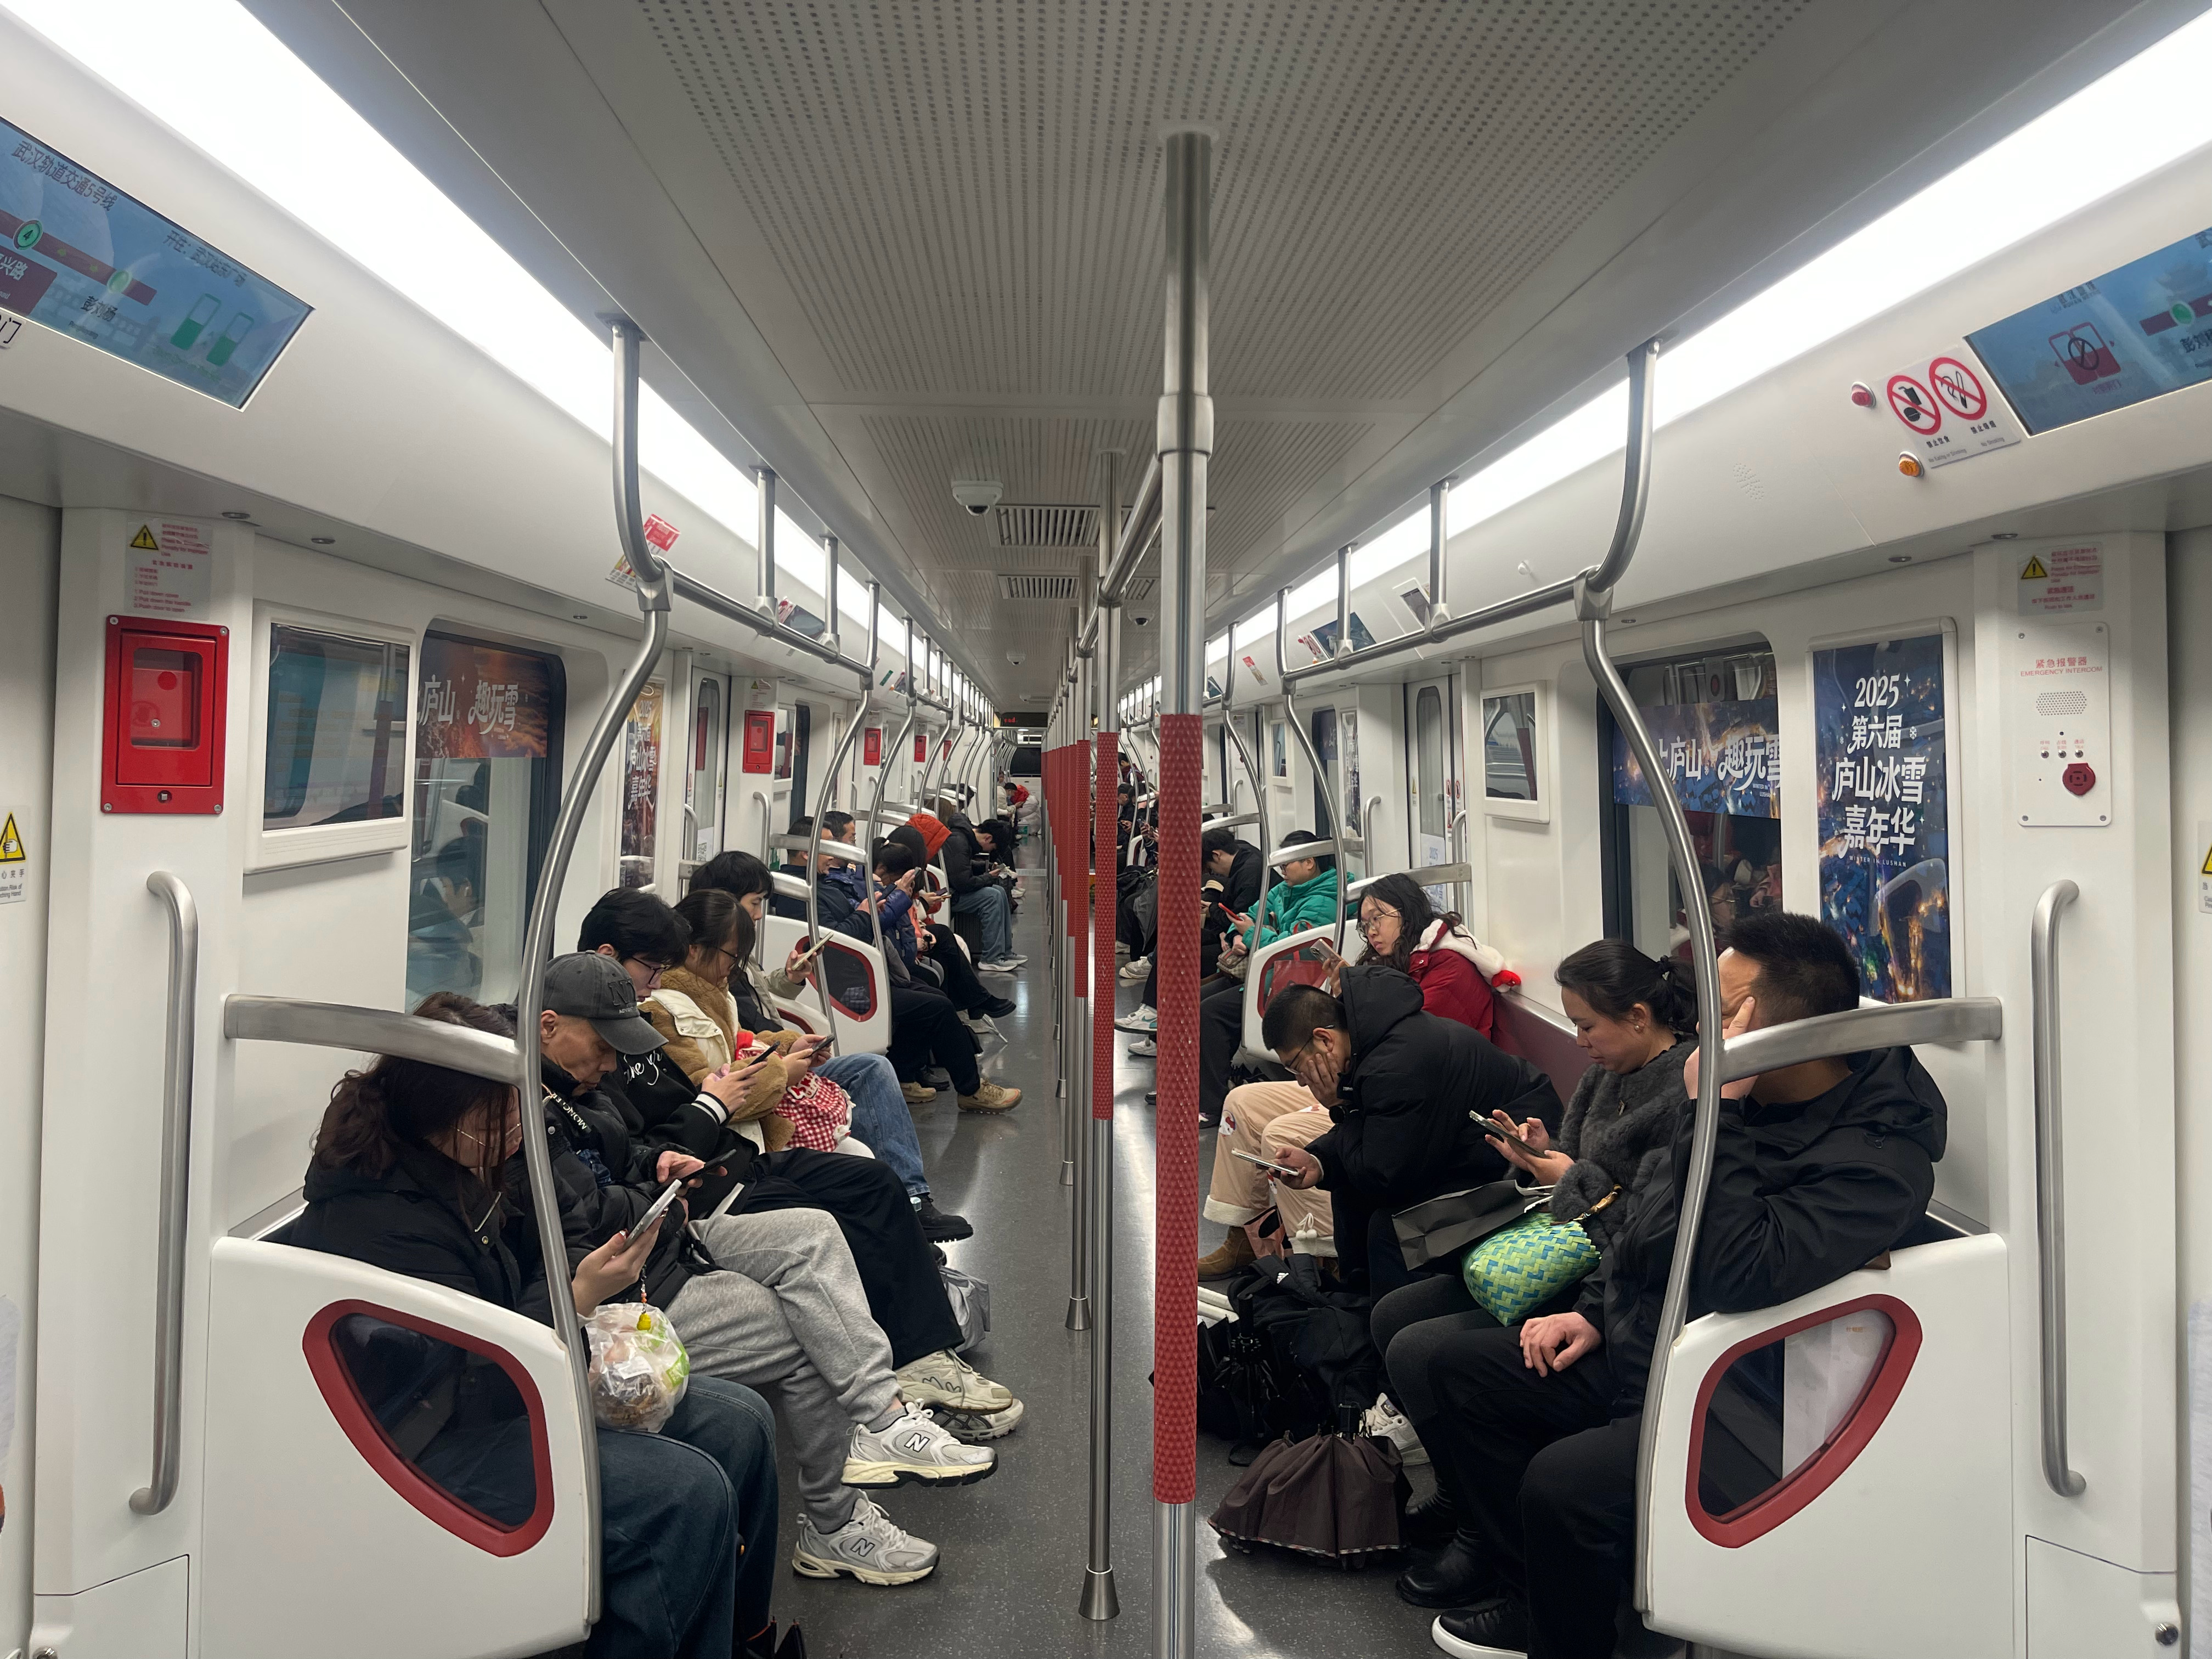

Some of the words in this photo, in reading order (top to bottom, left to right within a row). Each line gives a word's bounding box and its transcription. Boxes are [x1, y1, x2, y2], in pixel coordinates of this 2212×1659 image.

[12, 140, 117, 211] 武汉轨道交通5号线
[24, 229, 34, 240] 4
[0, 253, 28, 281] 兴路
[0, 314, 22, 343] 门
[2036, 657, 2087, 668] 紧急报警器
[417, 674, 456, 726] 庐山
[468, 680, 519, 735] 趣玩雪
[1854, 674, 1900, 709] 2025
[1847, 714, 1903, 754] 第六届
[1832, 755, 1926, 805] 庐山冰雪
[1838, 804, 1916, 859] 嘉年华
[904, 1433, 930, 1453] N
[851, 1538, 875, 1557] N
